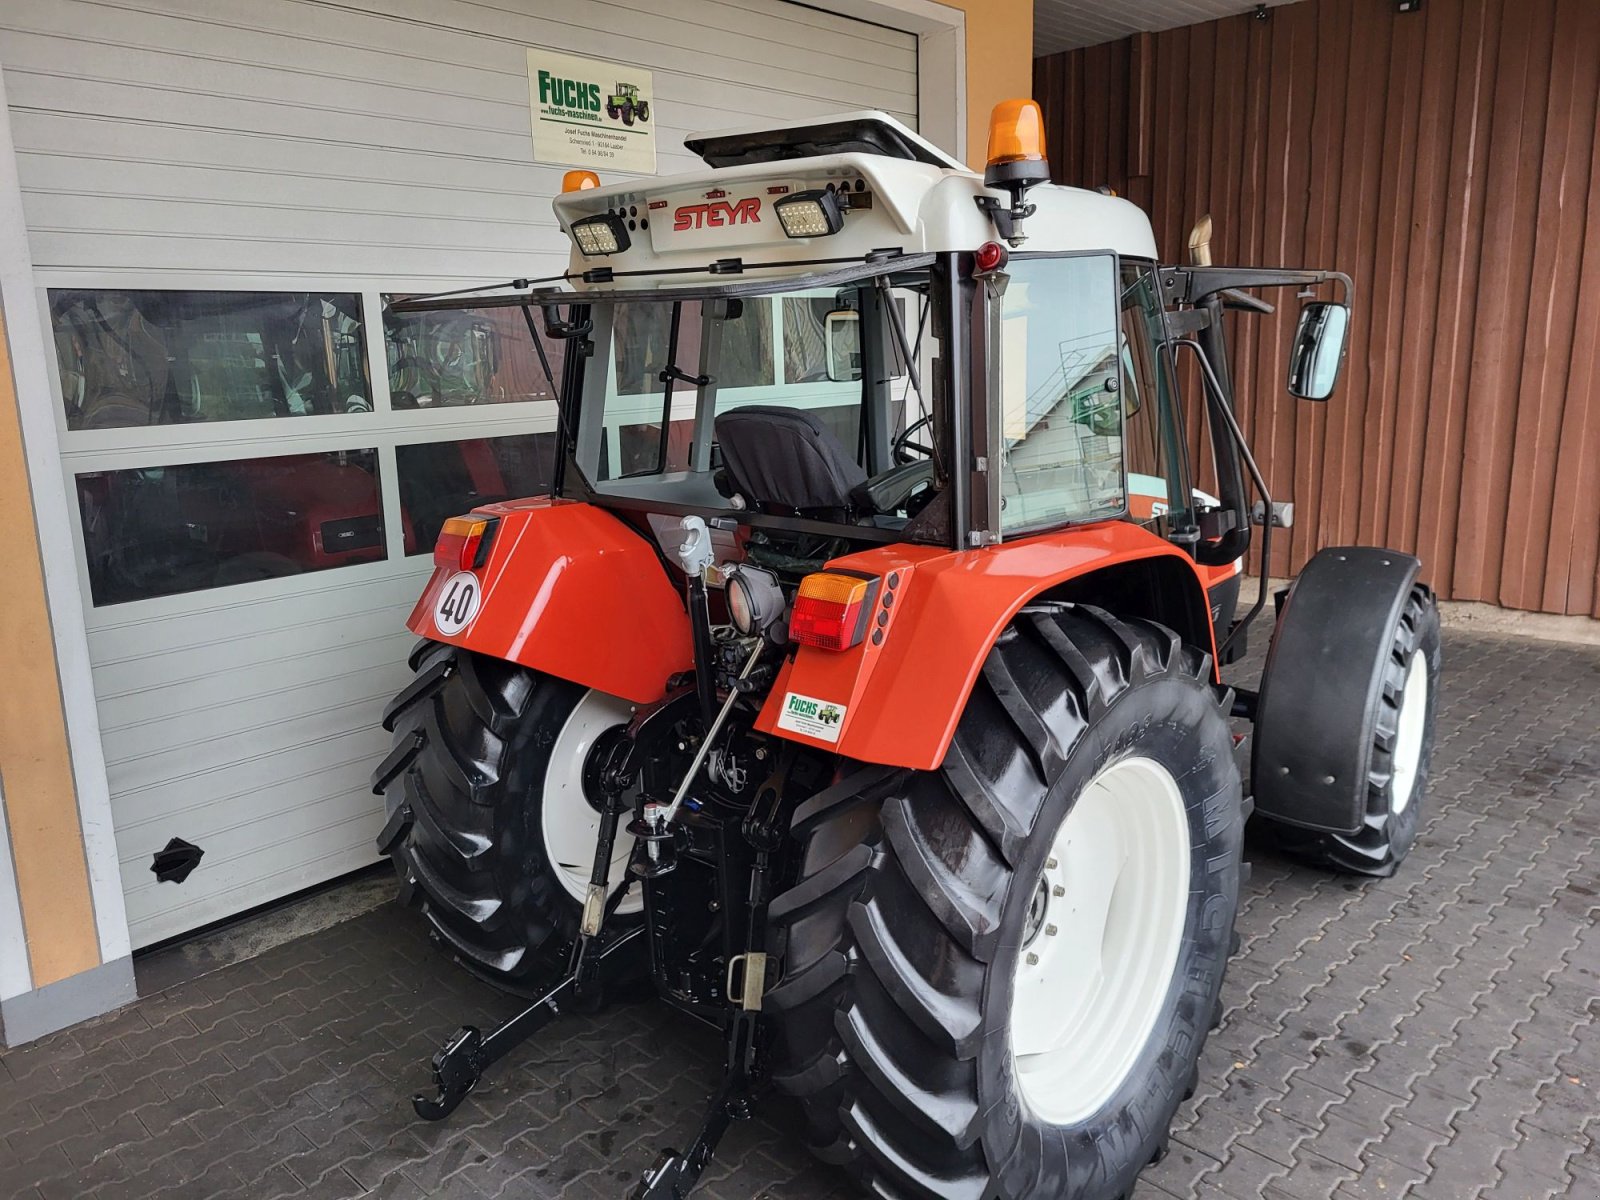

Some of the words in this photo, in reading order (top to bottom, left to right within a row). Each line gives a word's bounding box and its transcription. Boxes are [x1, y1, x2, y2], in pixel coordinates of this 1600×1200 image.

[538, 69, 601, 112] FUCHS
[673, 197, 762, 231] STEYR
[440, 581, 474, 625] 40
[788, 695, 818, 716] FUCHS
